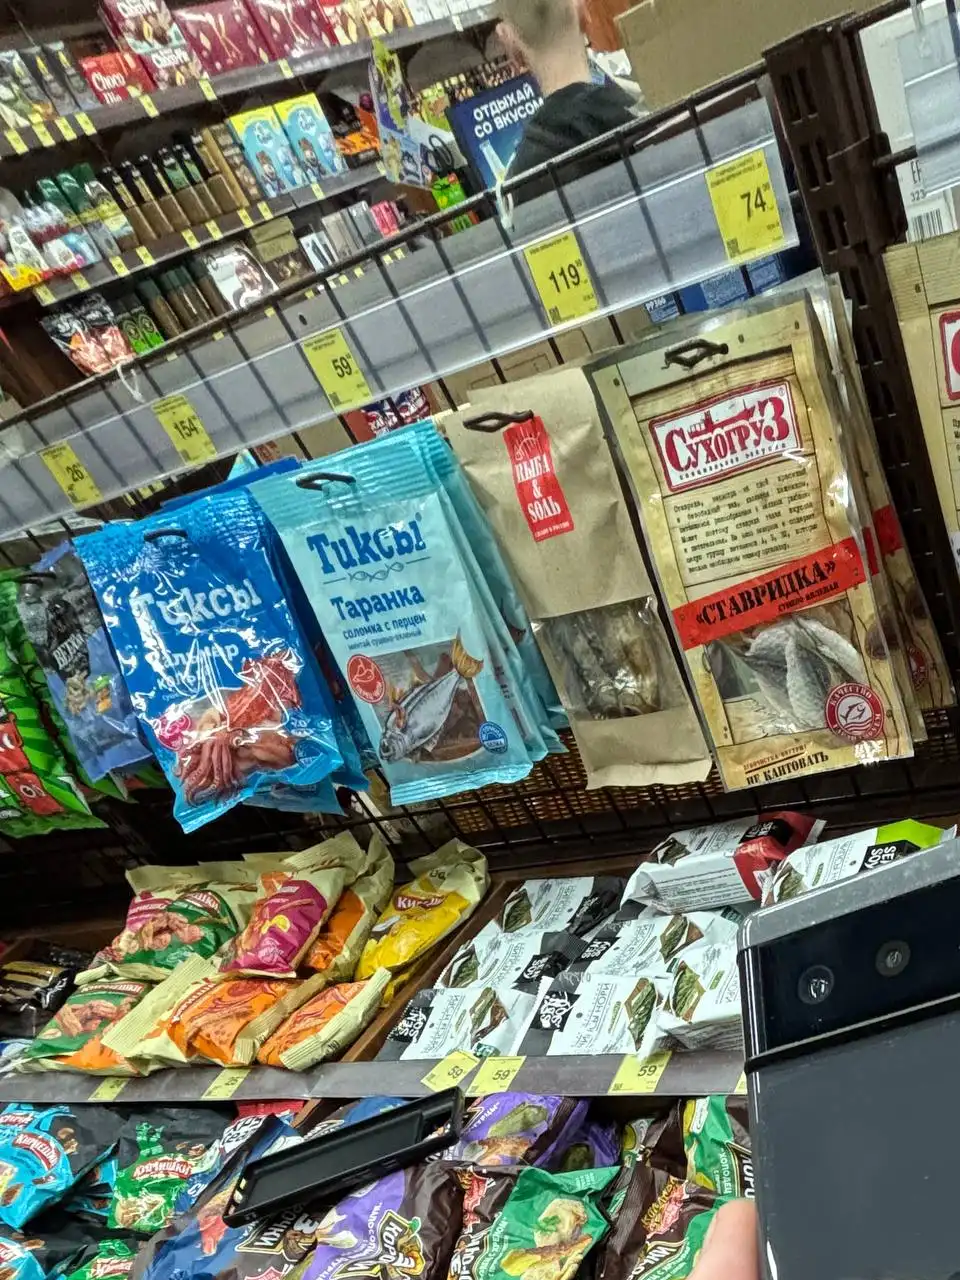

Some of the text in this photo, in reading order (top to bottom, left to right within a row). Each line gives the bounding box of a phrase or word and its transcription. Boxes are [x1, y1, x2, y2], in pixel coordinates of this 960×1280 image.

[473, 83, 536, 121] ОТДЫХАЙ
[474, 98, 545, 138] СО ВКУСОМ
[741, 186, 767, 221] 74
[549, 263, 581, 293] 119
[333, 358, 353, 378] 59
[173, 421, 199, 441] 154
[66, 465, 83, 482] 26
[532, 480, 542, 498] &
[306, 518, 427, 575] Тиксы
[329, 584, 426, 622] Таранка
[696, 559, 836, 627] «СТАВРИДКА»
[342, 623, 383, 640] соломка
[393, 613, 427, 636] перцем
[764, 752, 829, 783] КАНТОВАТЬ
[492, 1069, 511, 1081] 59
[637, 1063, 658, 1077] 59
